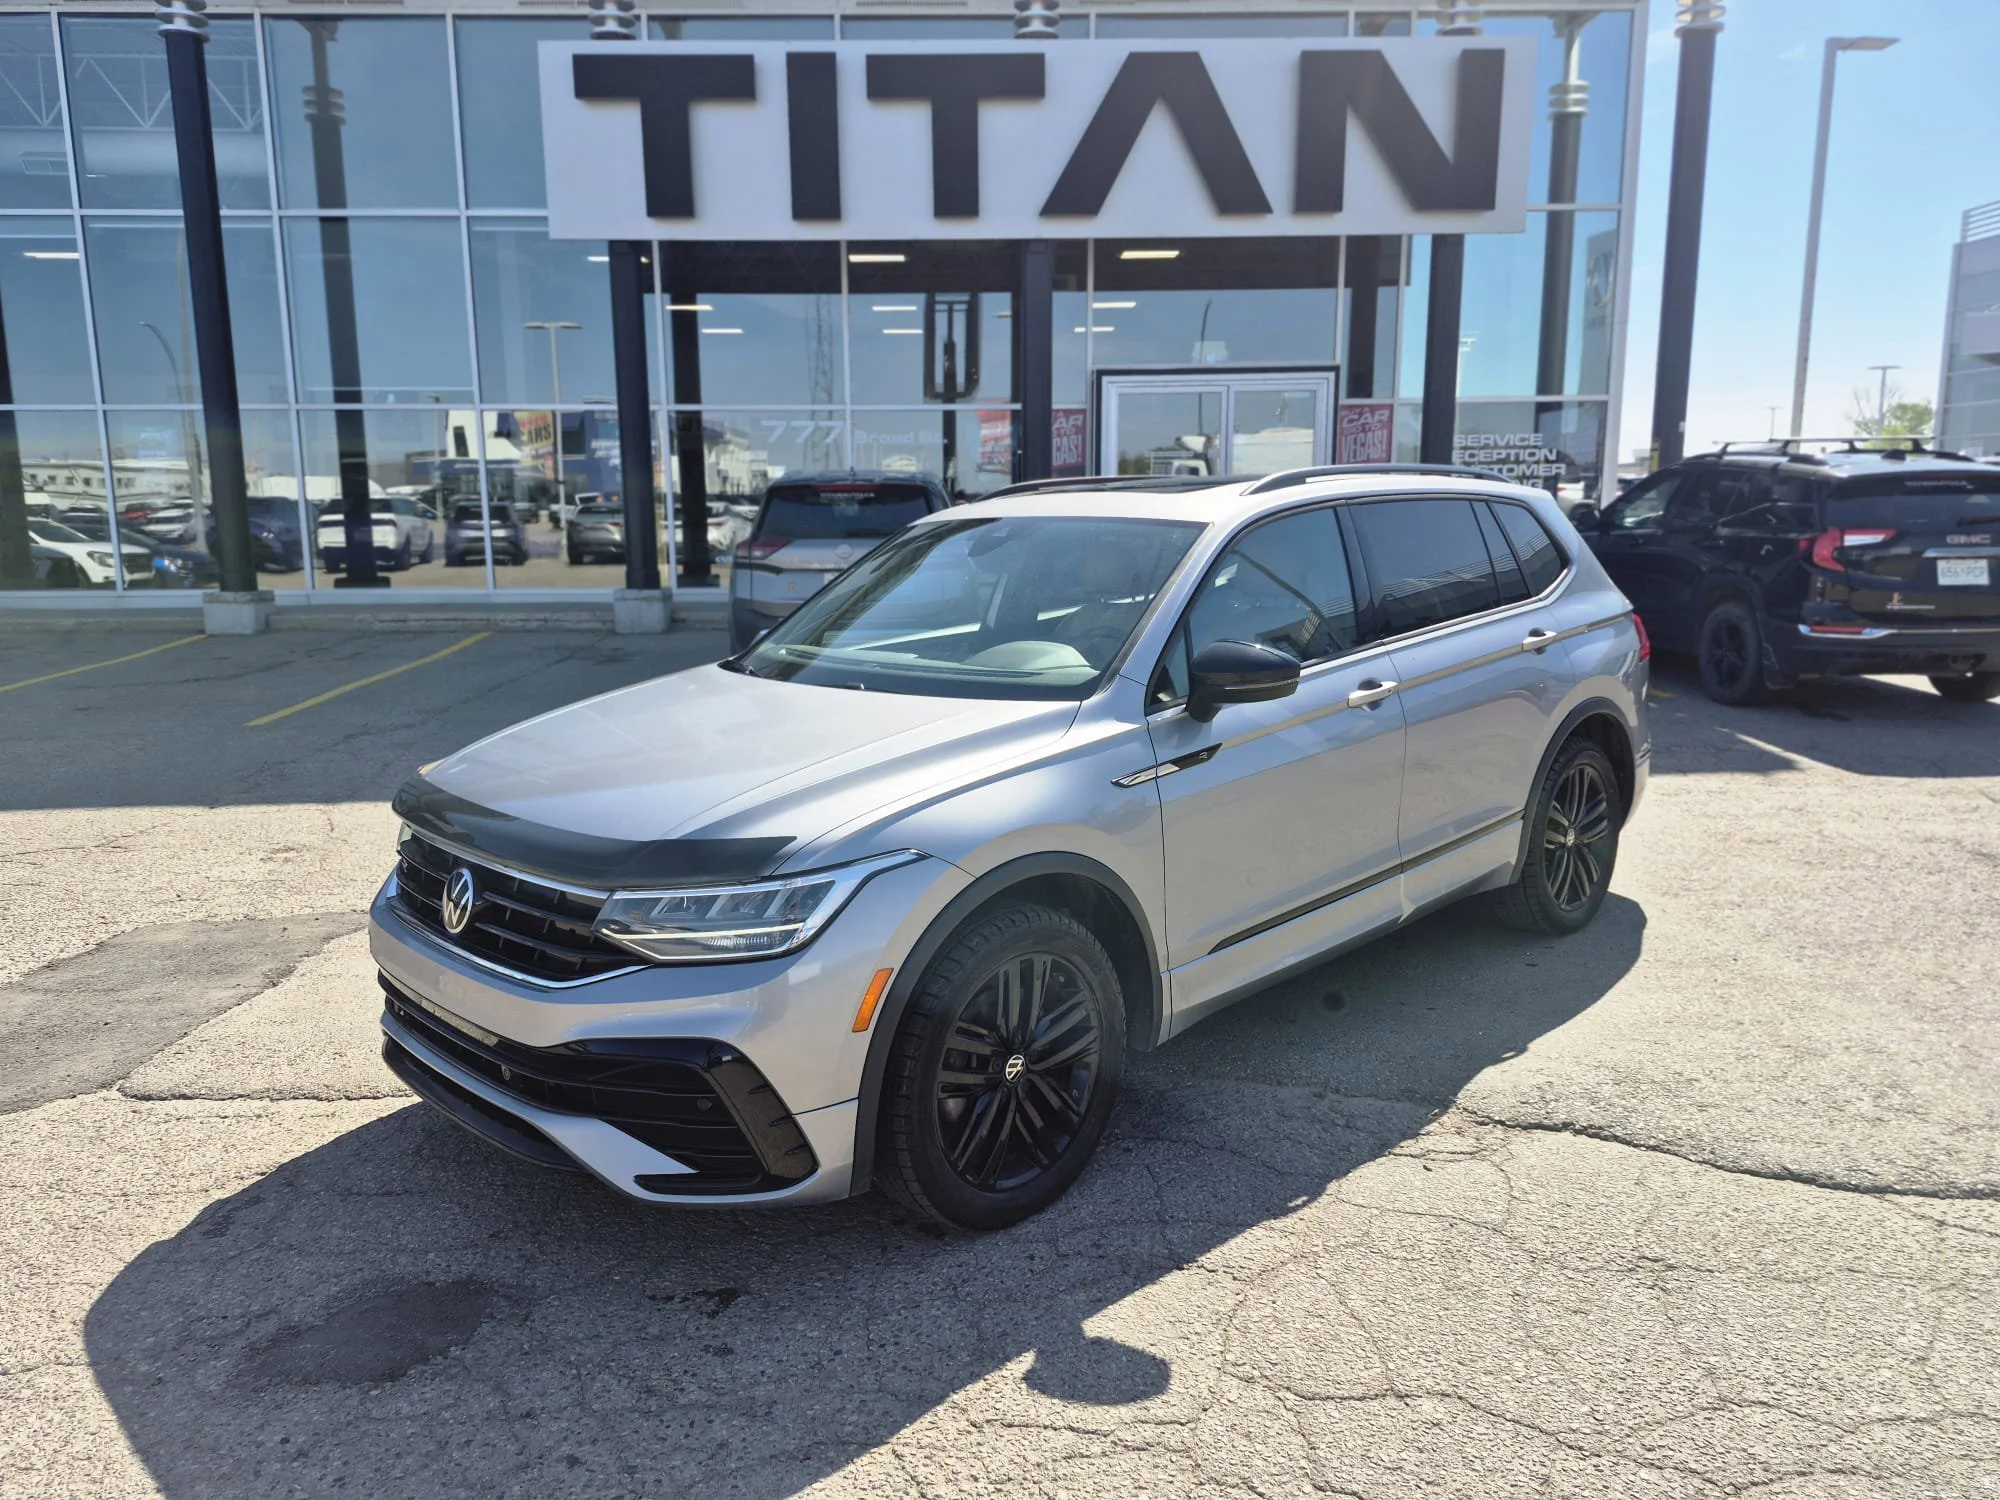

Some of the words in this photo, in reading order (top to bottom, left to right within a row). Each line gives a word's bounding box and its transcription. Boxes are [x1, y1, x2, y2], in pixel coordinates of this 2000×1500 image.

[573, 49, 1505, 222] TITAN
[1052, 415, 1084, 430] AR
[1342, 410, 1391, 428] CAR
[761, 420, 844, 444] 777
[854, 431, 915, 444] Broad
[1453, 433, 1543, 447] SERVICE
[1052, 434, 1083, 466] GAS!
[1341, 428, 1387, 464] VEGAS!
[1452, 448, 1557, 463] ECEPTION
[1946, 534, 1991, 544] GMC
